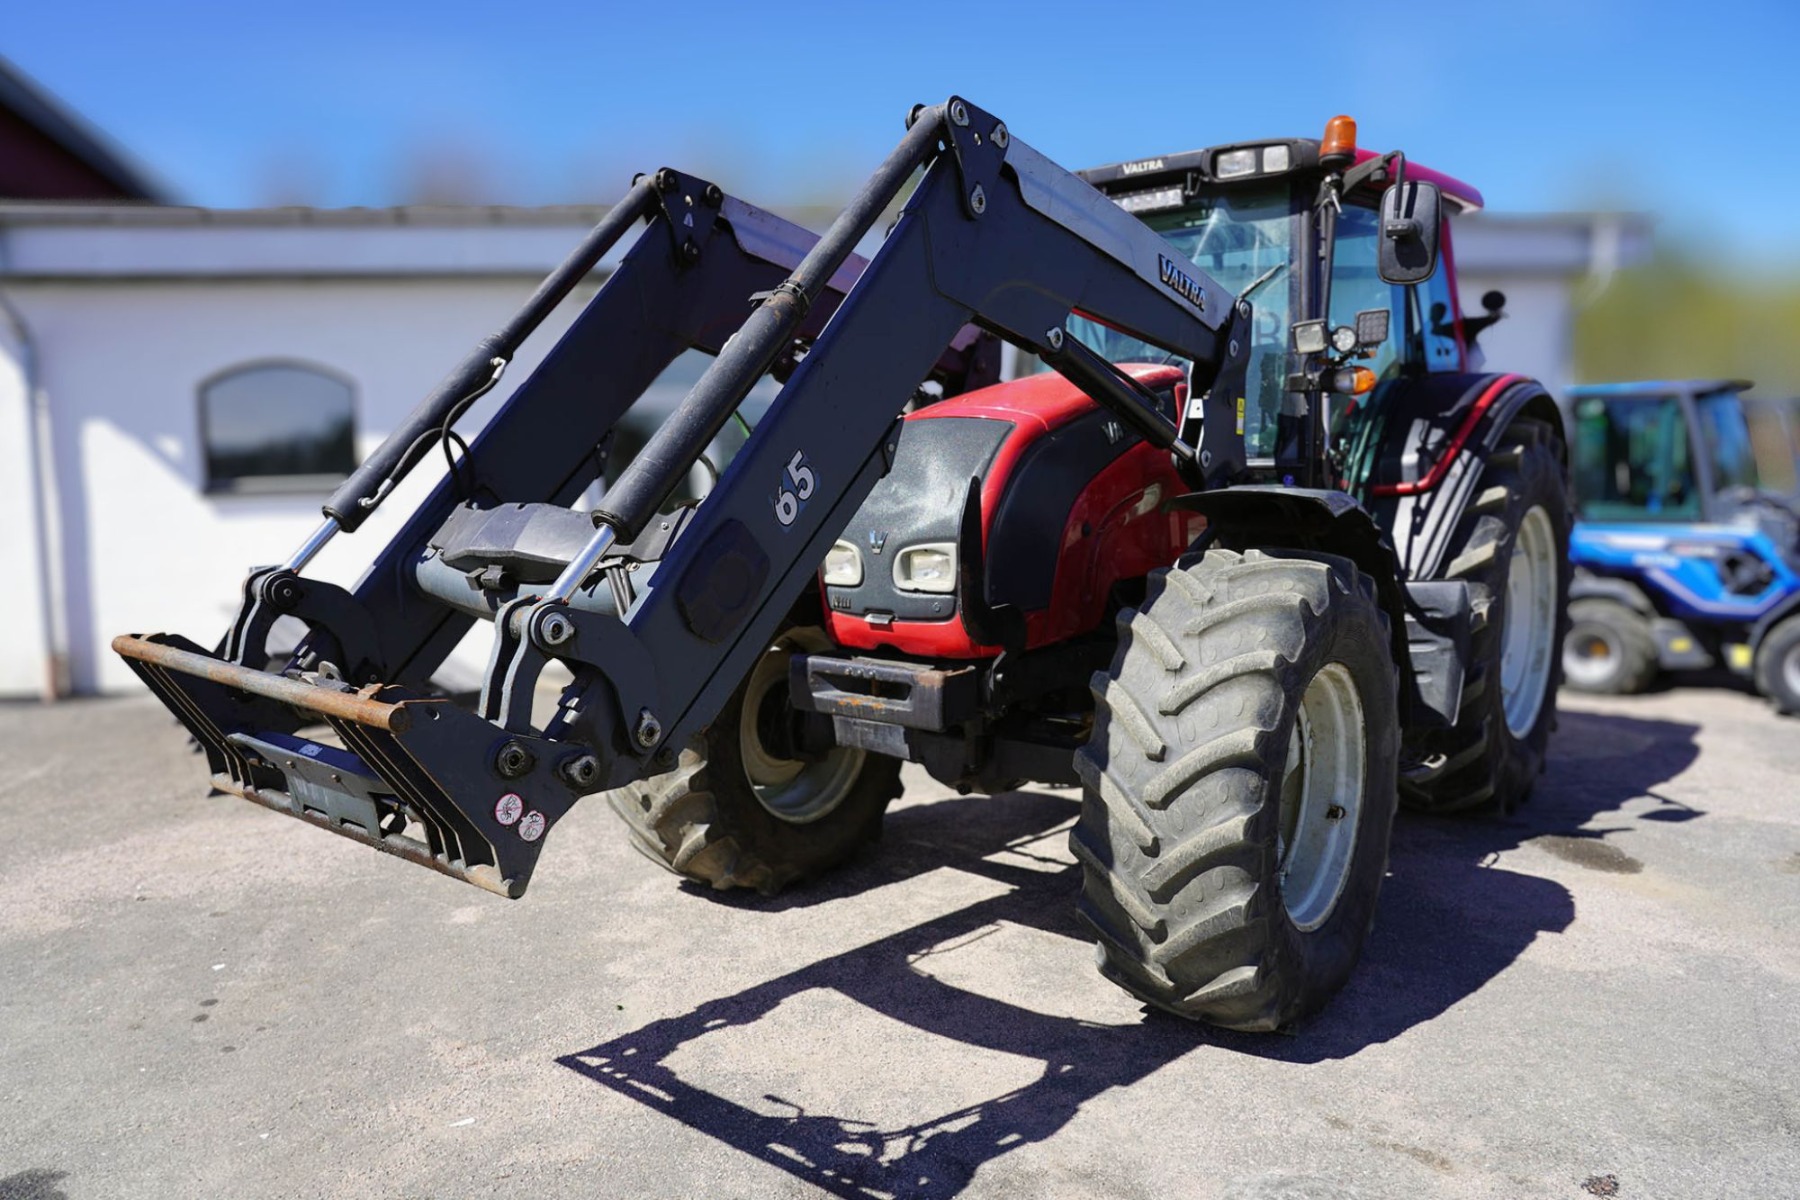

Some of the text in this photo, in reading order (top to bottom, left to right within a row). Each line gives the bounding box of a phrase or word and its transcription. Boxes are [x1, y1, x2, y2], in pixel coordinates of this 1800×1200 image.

[1123, 159, 1163, 175] VALTRA
[1158, 253, 1206, 312] VALTRA
[774, 449, 815, 526] 65
